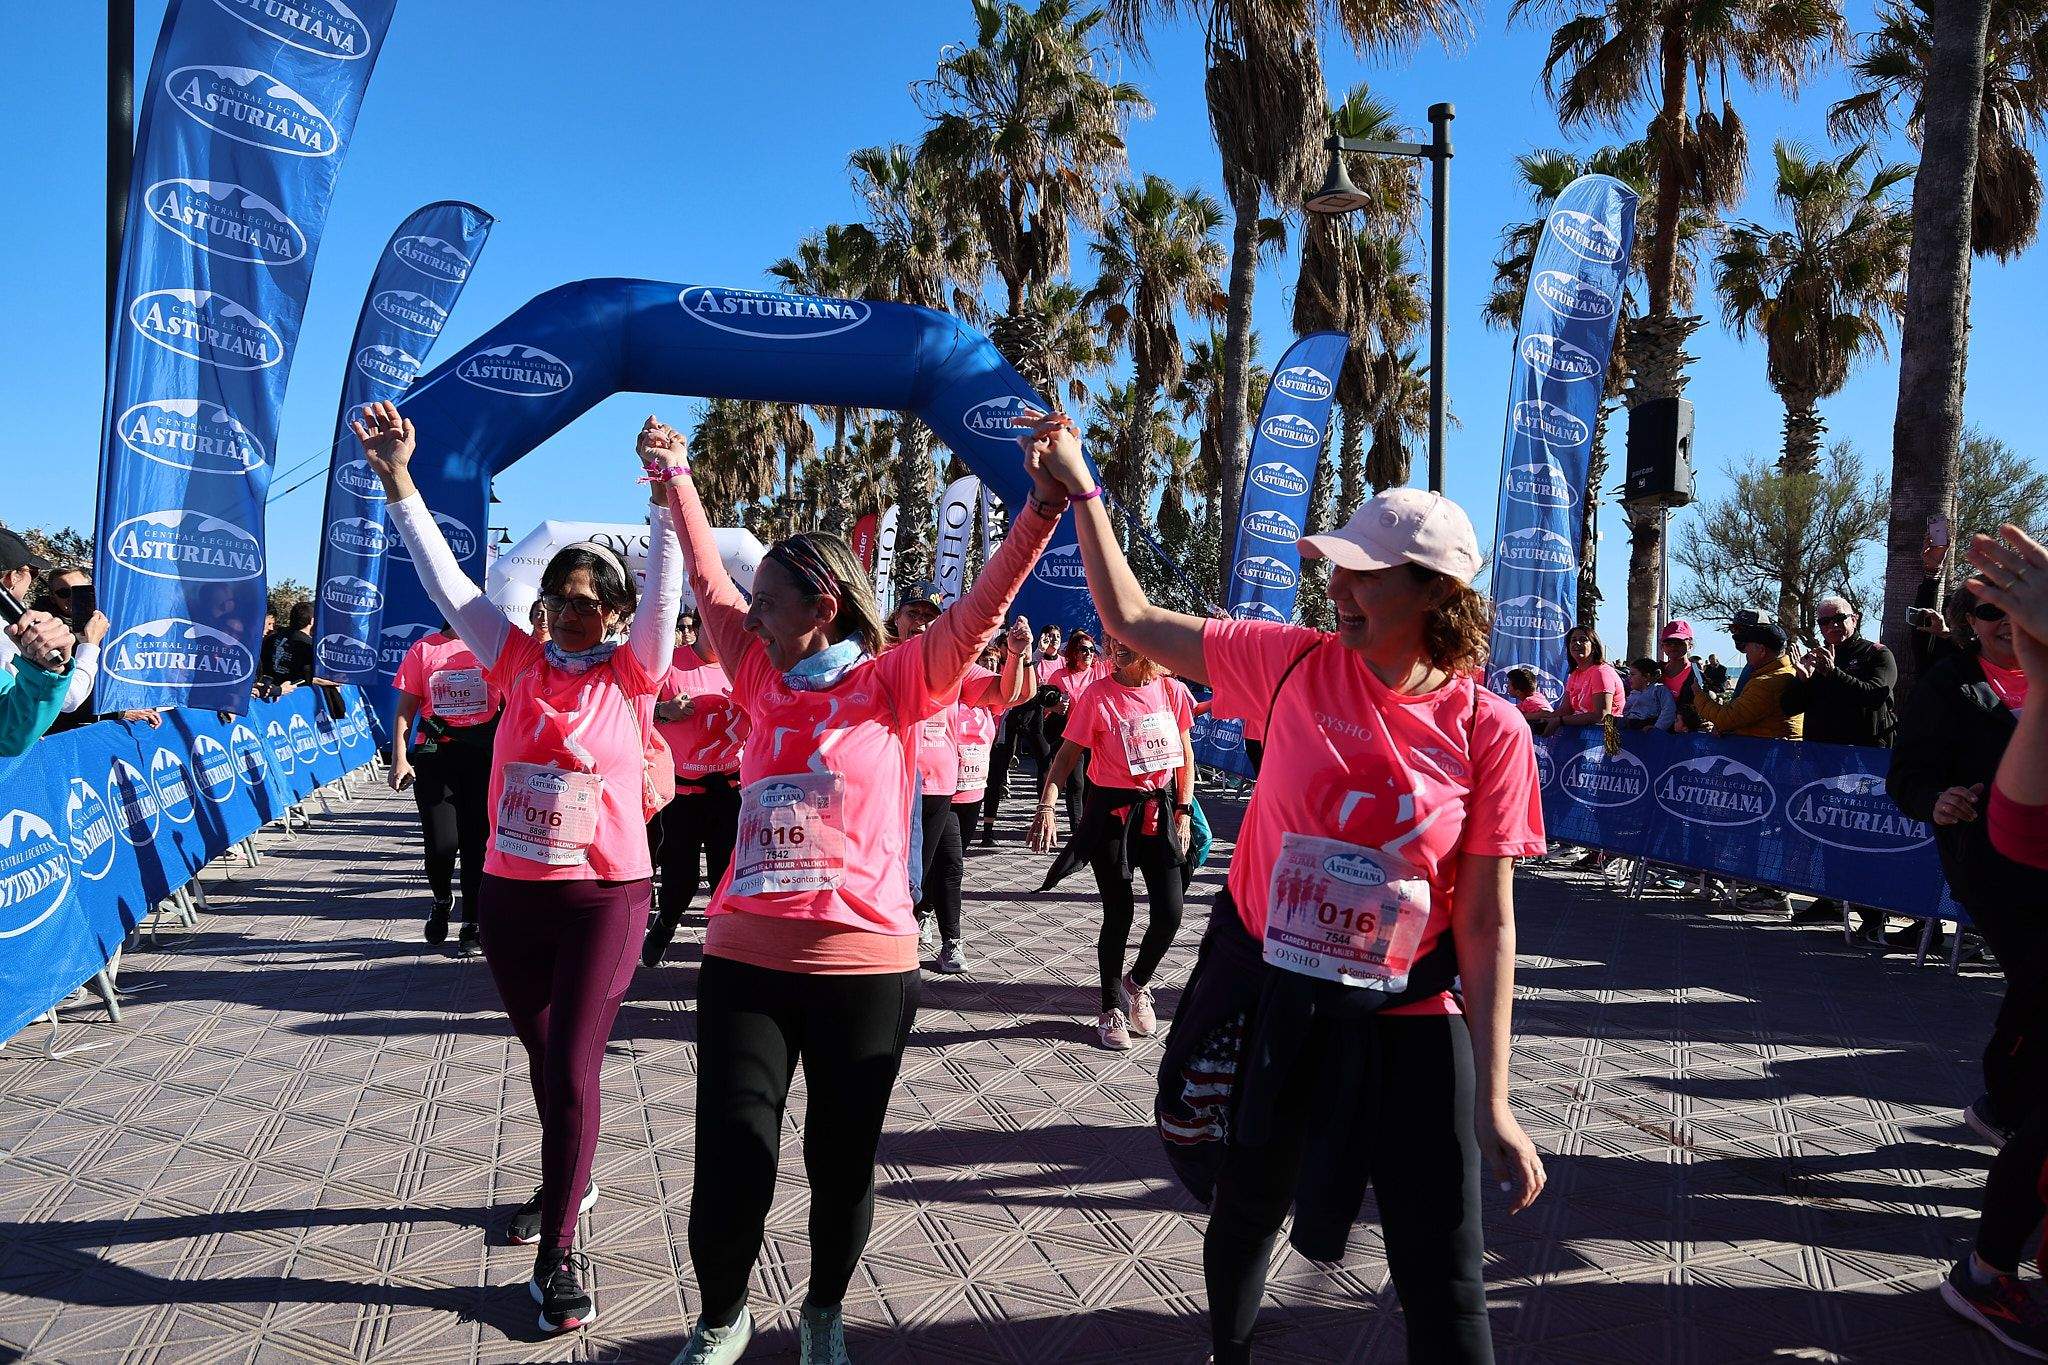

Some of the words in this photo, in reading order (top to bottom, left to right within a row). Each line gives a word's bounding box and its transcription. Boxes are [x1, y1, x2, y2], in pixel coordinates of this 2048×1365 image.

[177, 76, 322, 151] ASTURIANA
[212, 82, 263, 105] CENTRAL
[268, 101, 323, 130] LECHERA
[156, 190, 293, 258] ASTURIANA
[1555, 217, 1616, 260] ASTURIANA
[398, 241, 466, 280] ASTURIANA
[694, 289, 859, 320] ASTURIANA
[1538, 276, 1606, 315] ASTURIANA
[377, 296, 443, 332] ASTURIAN
[141, 302, 269, 362] ASTURIANA
[483, 358, 521, 367] CENTRAL
[524, 361, 562, 372] LECHERA
[1524, 341, 1593, 374] ASTURIANA
[464, 360, 564, 388] ASTURIANA
[1278, 374, 1328, 396] ASTURIANA
[157, 416, 210, 433] CENTRAL
[1264, 421, 1314, 444] ASTURIANA
[128, 414, 250, 467] ASTURIAA
[340, 469, 384, 492] ASTURIA
[1255, 469, 1303, 492] ASTURIANA
[144, 530, 196, 542] CENTRAL
[201, 536, 256, 550] LECHERA
[1247, 517, 1297, 540] ASTURIANA
[117, 530, 257, 572] ASTURIANA
[588, 532, 651, 559] OYS
[939, 501, 968, 604] YSHO
[1501, 539, 1572, 566] ASTURIANA
[1038, 561, 1086, 579] ASTUR
[1239, 563, 1292, 586] ASTURIANA
[1495, 609, 1565, 633] ASTURIANA
[114, 643, 243, 677] ASTURIANA
[136, 641, 182, 649] CENTRAL
[187, 643, 241, 657] LECHERA
[450, 689, 470, 698] 016
[1314, 711, 1373, 742] OYSHO
[1146, 737, 1168, 749] 016
[964, 765, 980, 773] 016
[1565, 764, 1640, 795] ASTURIANA
[1658, 774, 1763, 814] ASTURIANA
[1822, 794, 1868, 808] CENTRAL
[113, 794, 158, 830] ASTURIANA
[525, 806, 562, 827] 016
[1794, 793, 1928, 839] ASTURIANA
[502, 840, 527, 852] OYSHO
[553, 841, 577, 849] VALENCIA
[760, 825, 804, 846] 016
[0, 851, 24, 872] ENTRAL
[766, 850, 789, 860] 7542
[792, 876, 830, 884] Santander
[1327, 860, 1381, 883] ASTURIANA
[1318, 902, 1376, 933] 016
[1281, 933, 1309, 949] CARRERA
[1322, 945, 1331, 953] LA
[1333, 947, 1355, 958] MUJER
[1325, 932, 1350, 945] 7544
[1276, 948, 1319, 968] OYSHO
